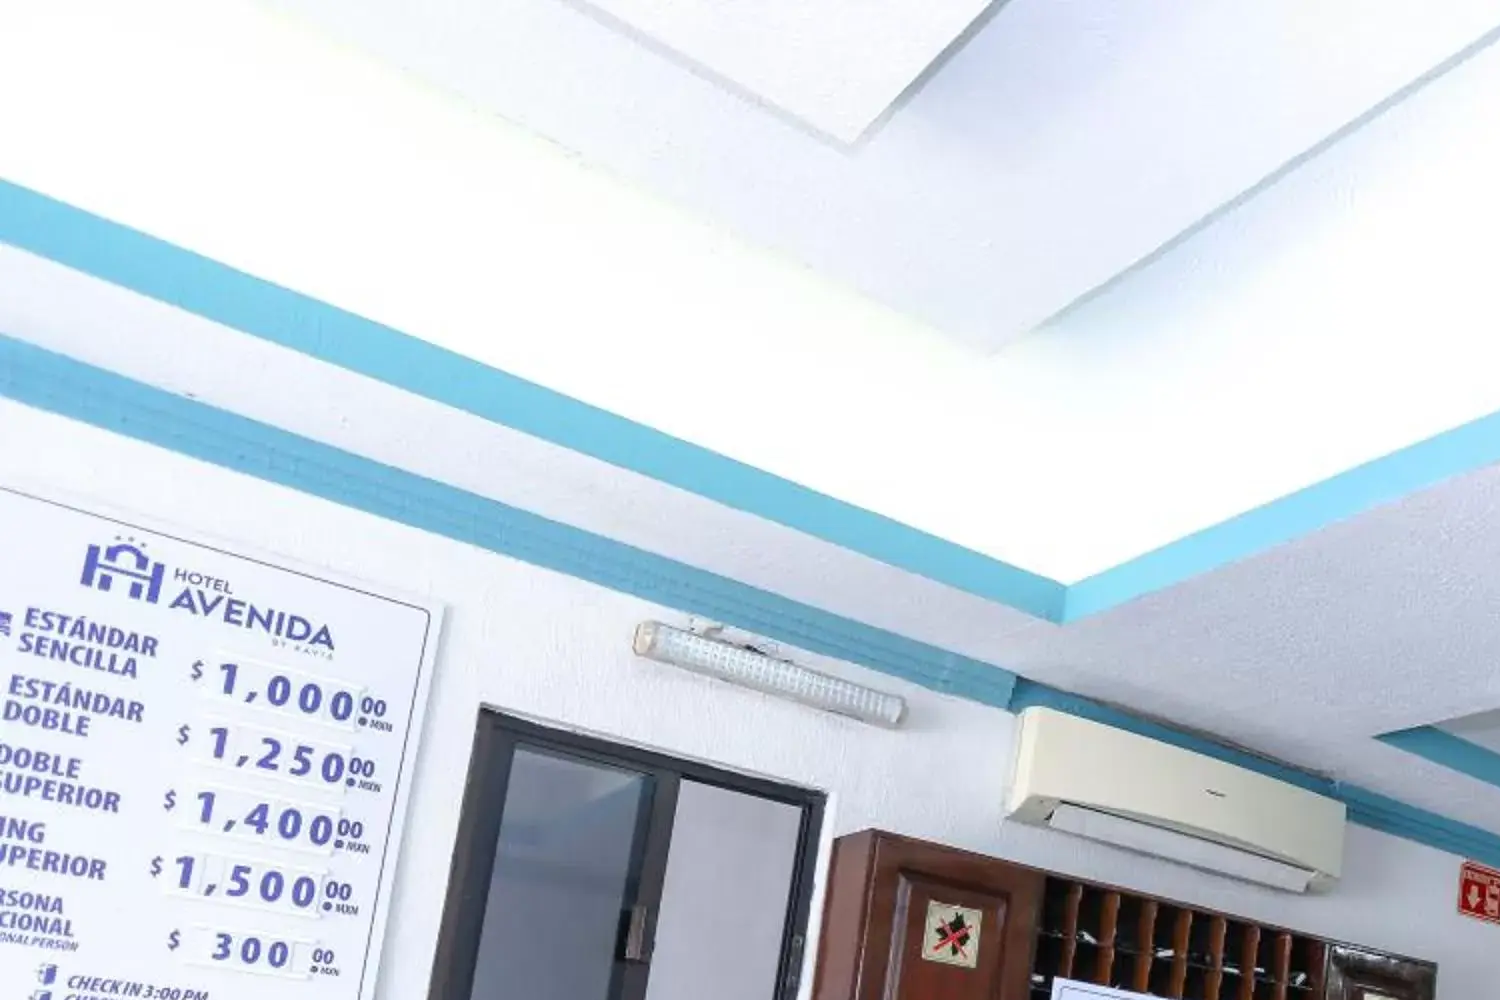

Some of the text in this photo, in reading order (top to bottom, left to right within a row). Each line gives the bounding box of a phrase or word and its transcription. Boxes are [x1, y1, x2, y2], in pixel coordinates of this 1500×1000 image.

[174, 567, 234, 594] HOTEL
[24, 607, 159, 657] ESTÁNDAR
[168, 587, 335, 650] AVENIDA
[17, 632, 138, 680] SENCILLA
[8, 674, 145, 722] ESTÁNDAR
[191, 660, 387, 721] $ 1,000 00
[3, 699, 92, 737] DOBLE
[176, 724, 375, 783] $ 1,250 00
[0, 770, 121, 813] UPERIOR
[163, 789, 363, 846] $ 1,400 00
[150, 856, 352, 908] $ 1,500 00
[31, 935, 79, 953] PERSON
[167, 929, 334, 968] $ 300 00
[67, 975, 123, 996] CHECK
[123, 982, 143, 997] IN
[143, 985, 181, 1000] 3:00
